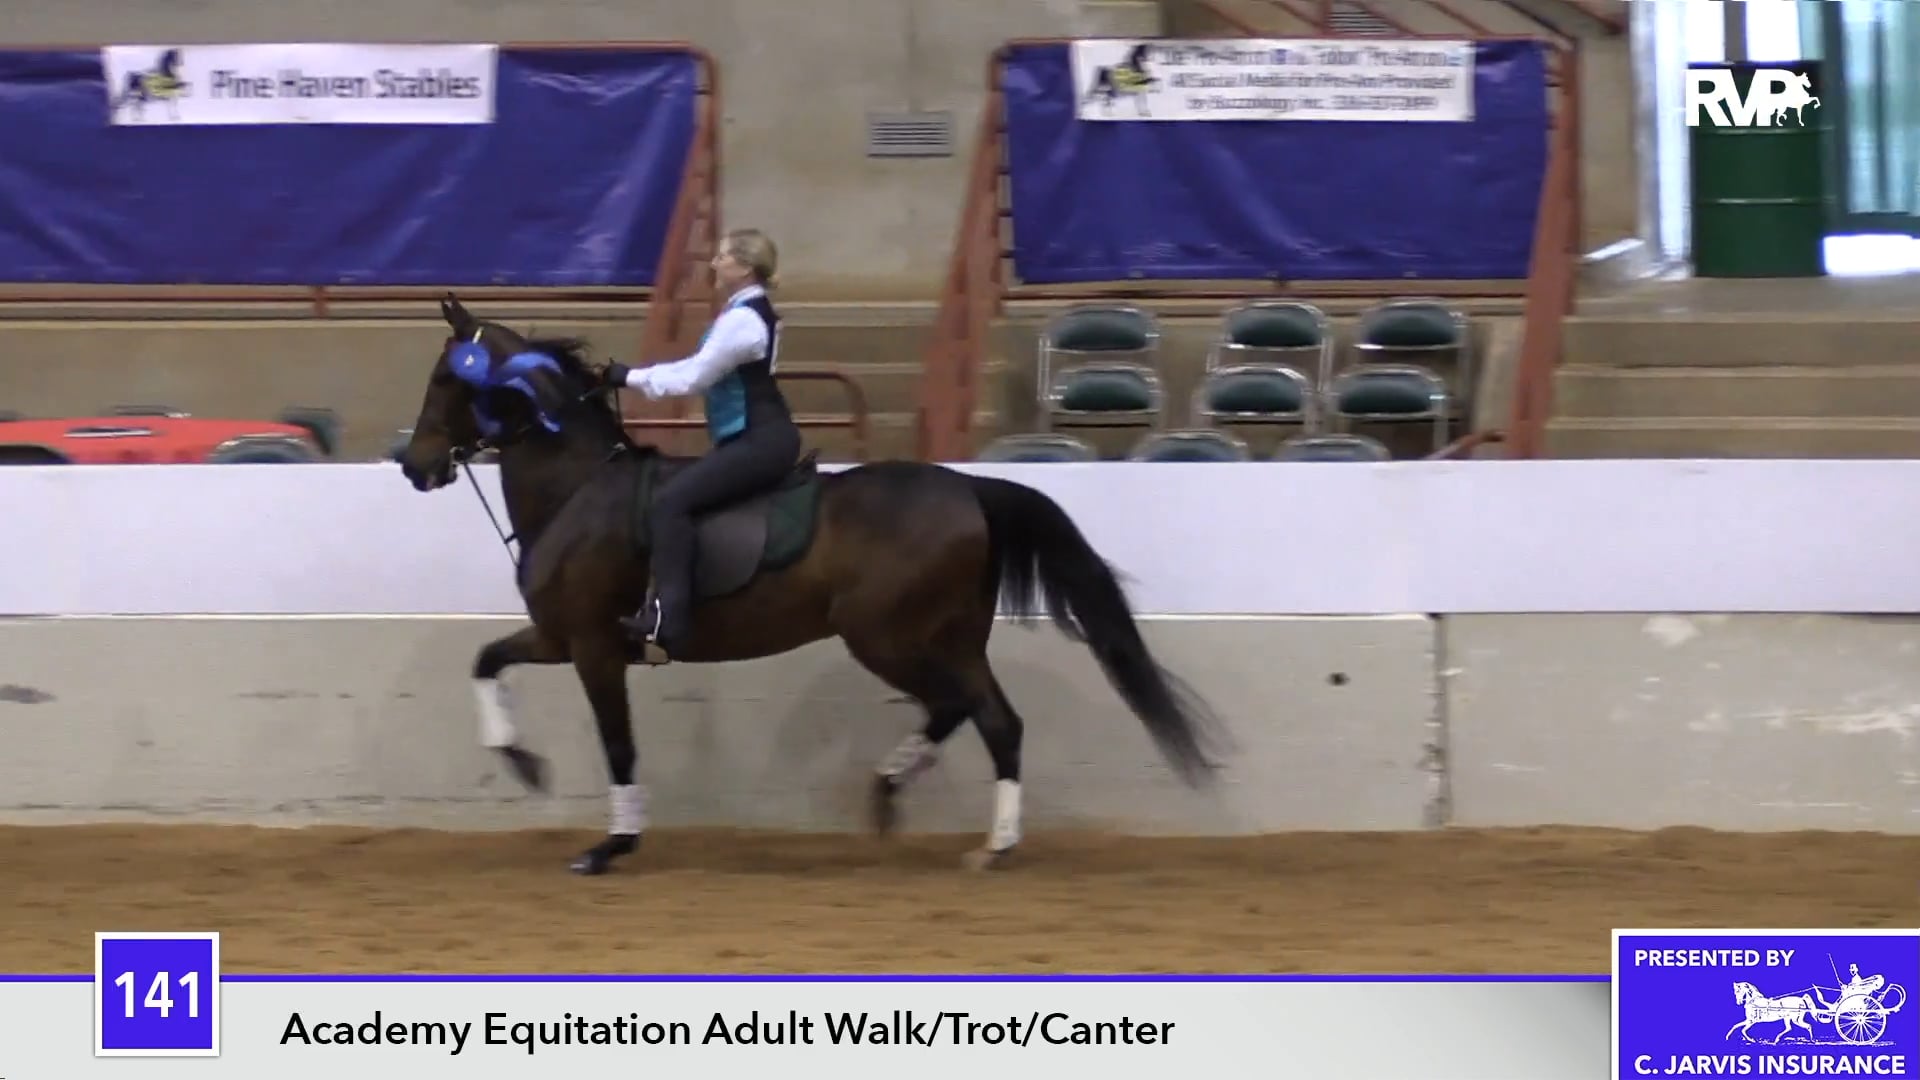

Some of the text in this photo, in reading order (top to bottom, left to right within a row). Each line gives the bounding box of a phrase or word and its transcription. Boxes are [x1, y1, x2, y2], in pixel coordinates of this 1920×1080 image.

[210, 68, 481, 99] Pine Haven Stables
